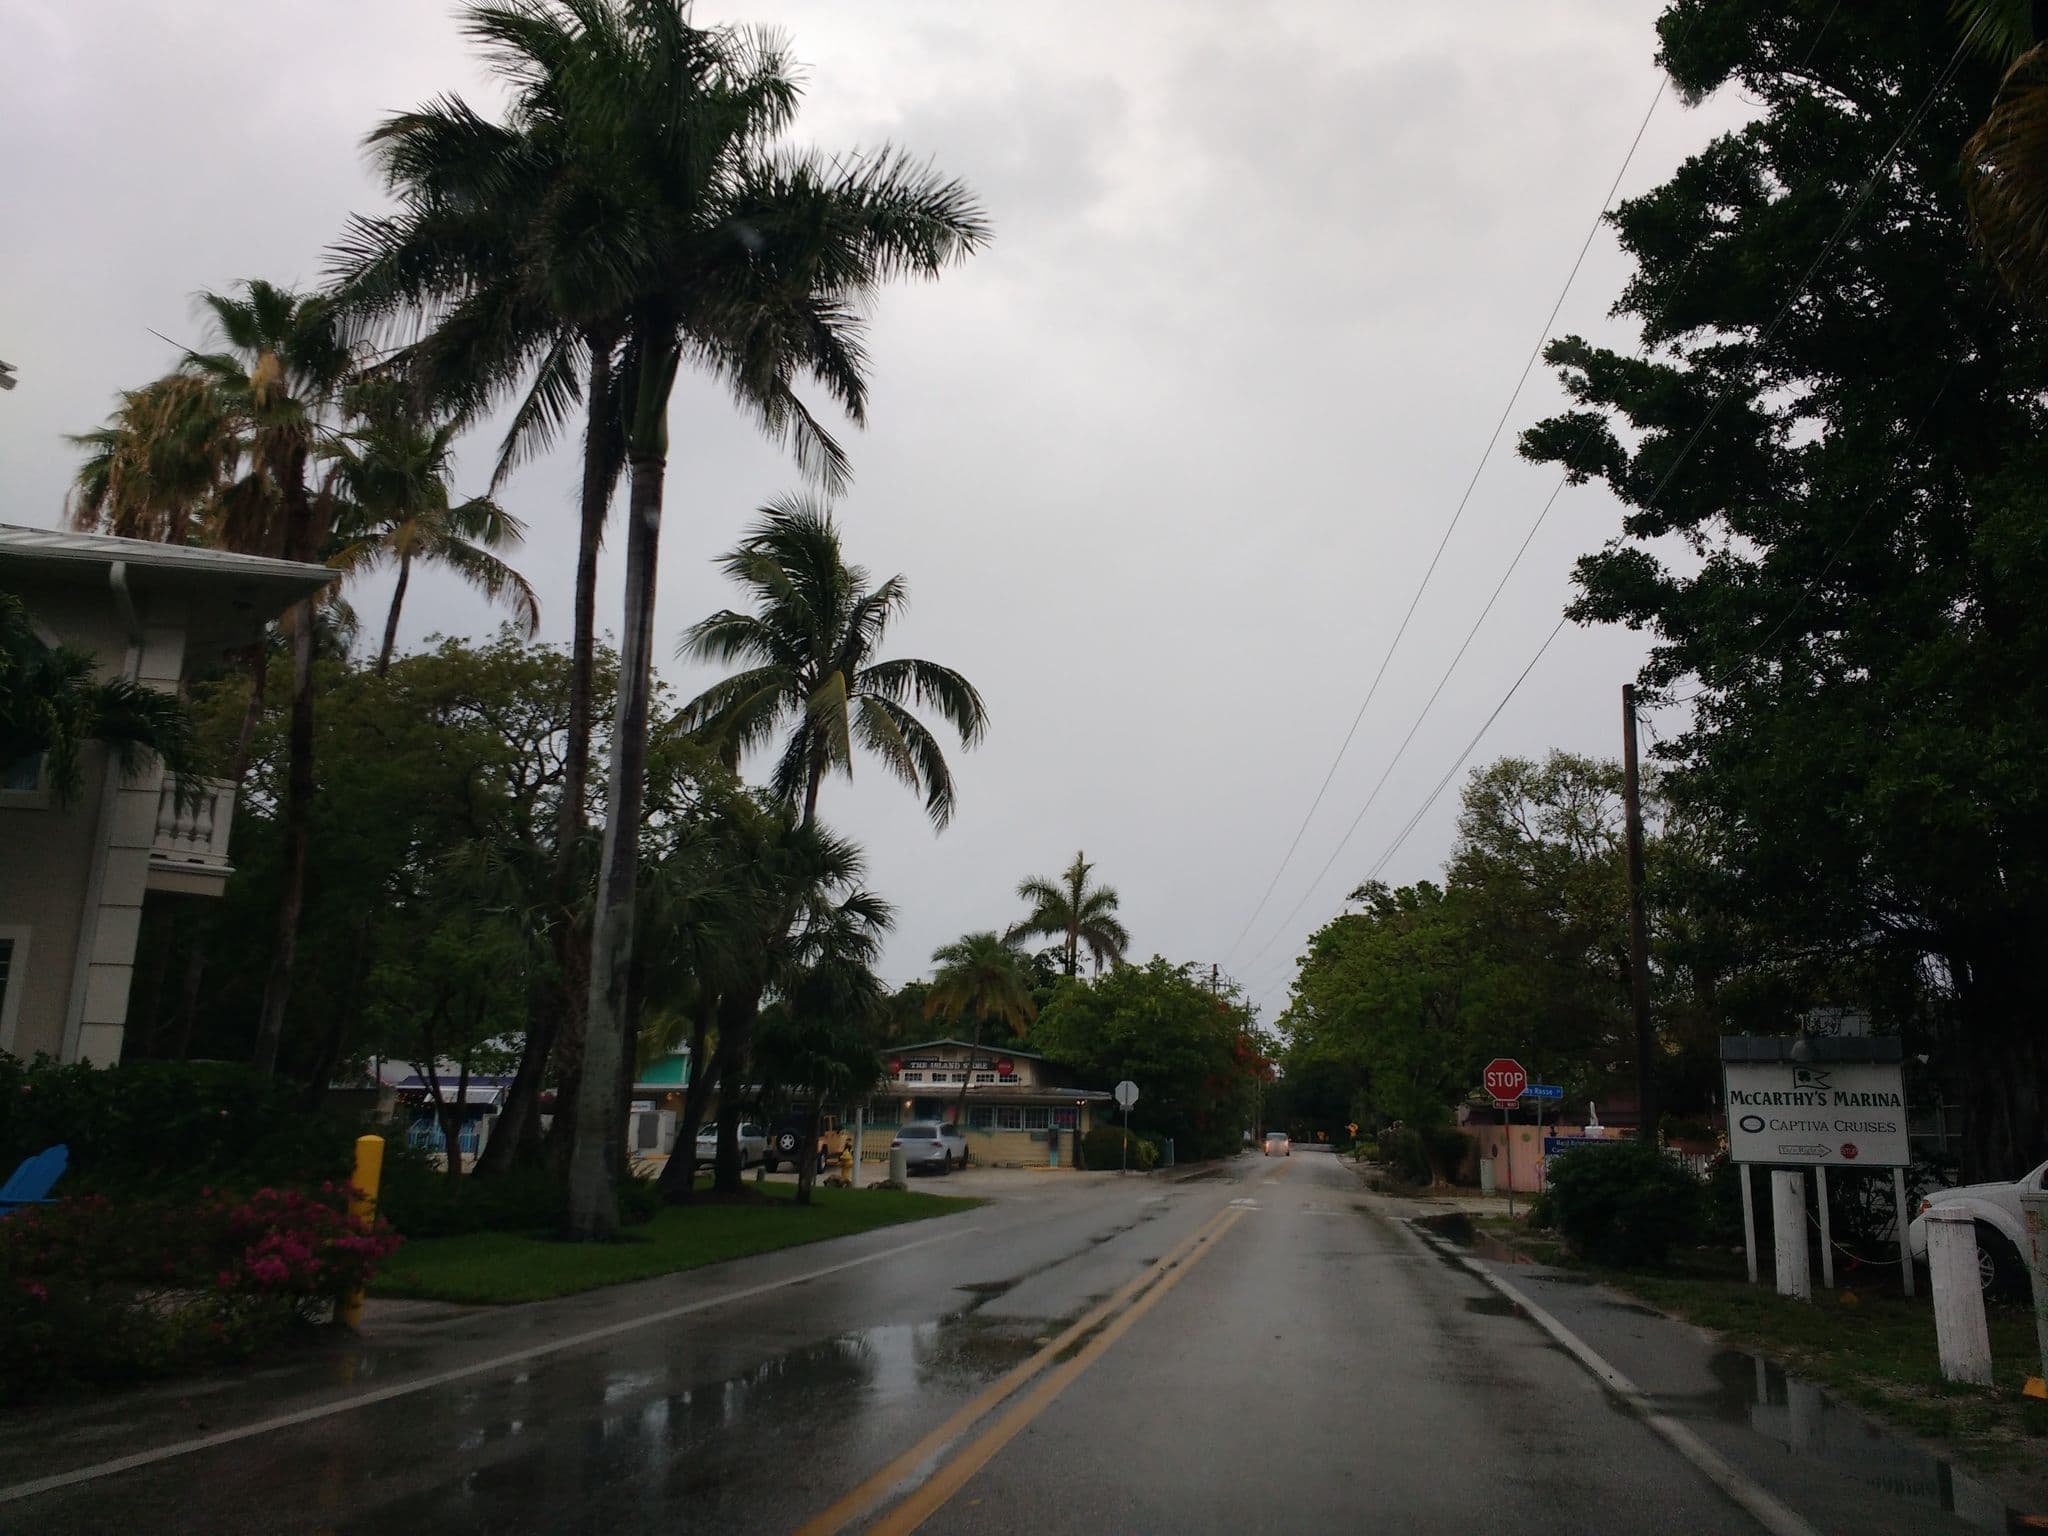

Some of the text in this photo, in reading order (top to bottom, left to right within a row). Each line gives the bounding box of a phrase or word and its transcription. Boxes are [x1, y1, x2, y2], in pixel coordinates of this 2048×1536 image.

[1487, 1072, 1523, 1088] STOP
[1834, 1091, 1901, 1107] MARINA
[1769, 1119, 1830, 1132] CAPTIVA
[1834, 1120, 1897, 1133] CRUISES
